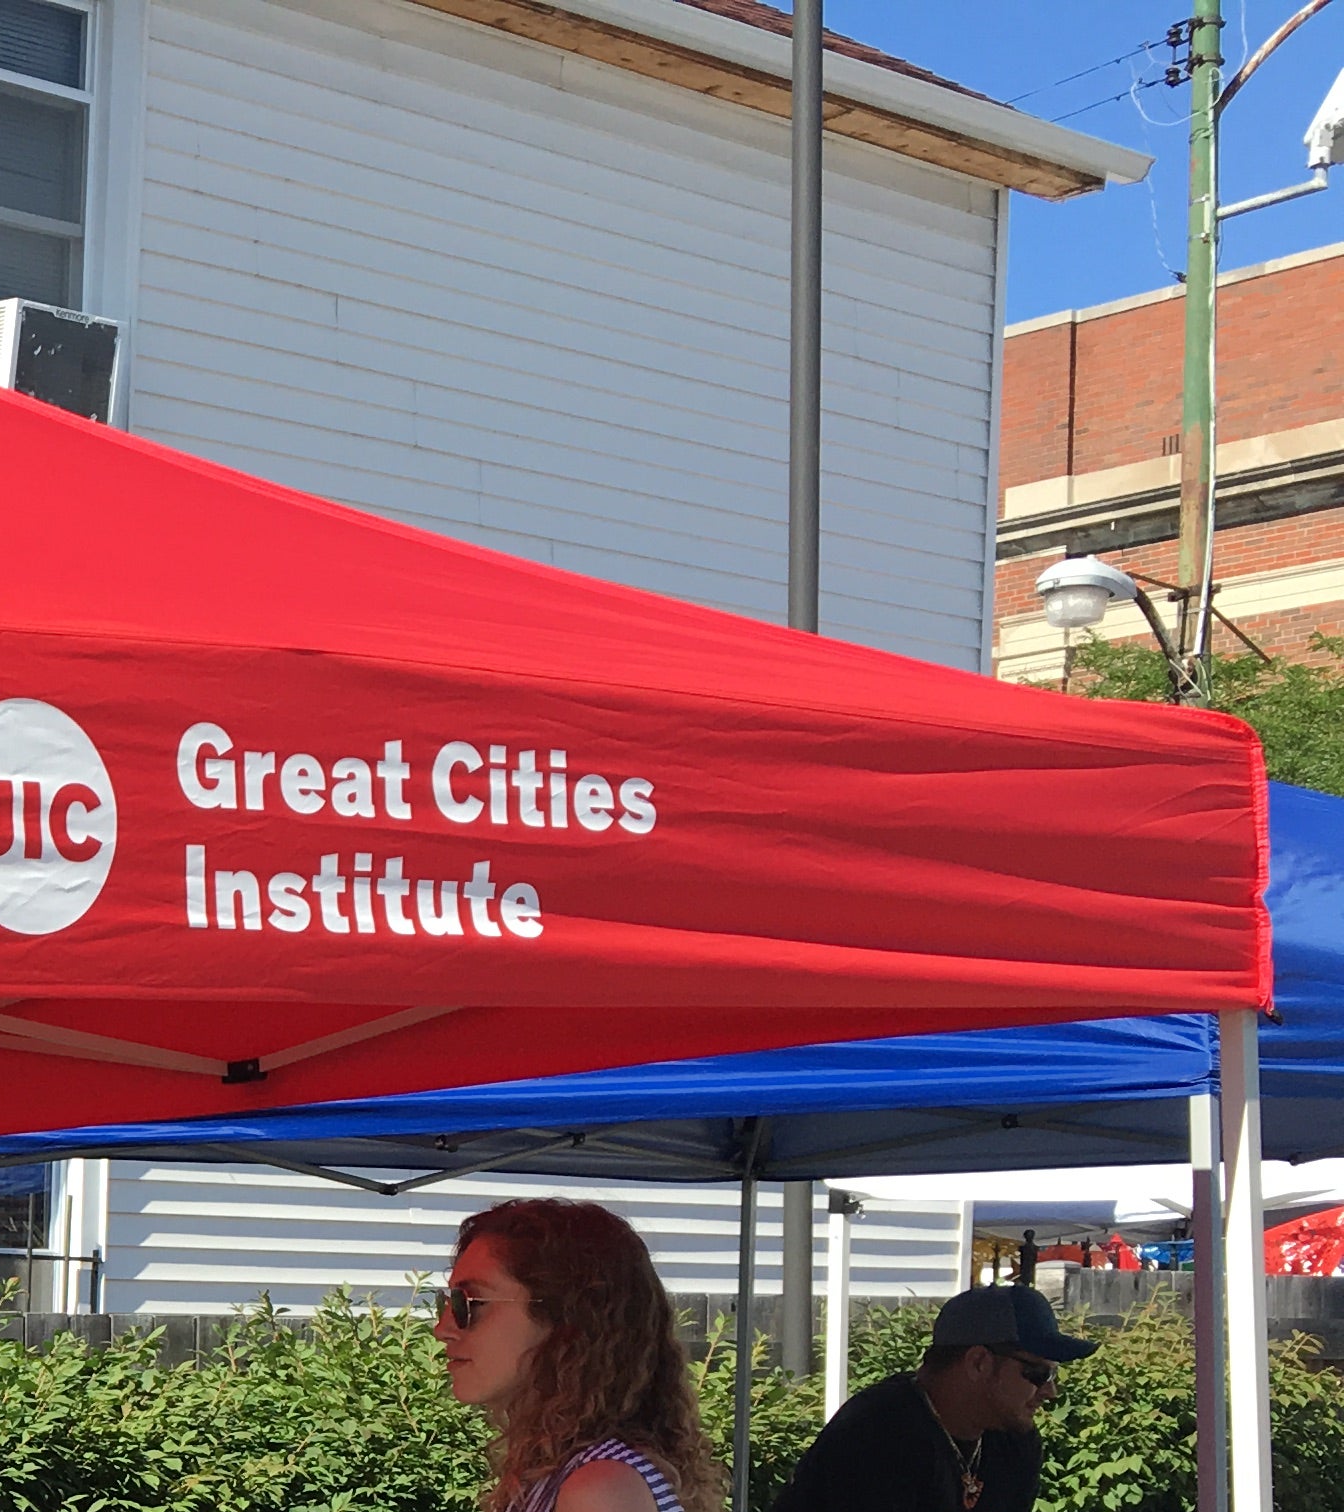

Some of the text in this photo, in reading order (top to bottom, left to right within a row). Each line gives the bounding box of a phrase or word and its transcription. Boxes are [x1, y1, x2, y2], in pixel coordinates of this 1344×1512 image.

[176, 722, 657, 834] Great Cities
[185, 844, 544, 938] Institute
